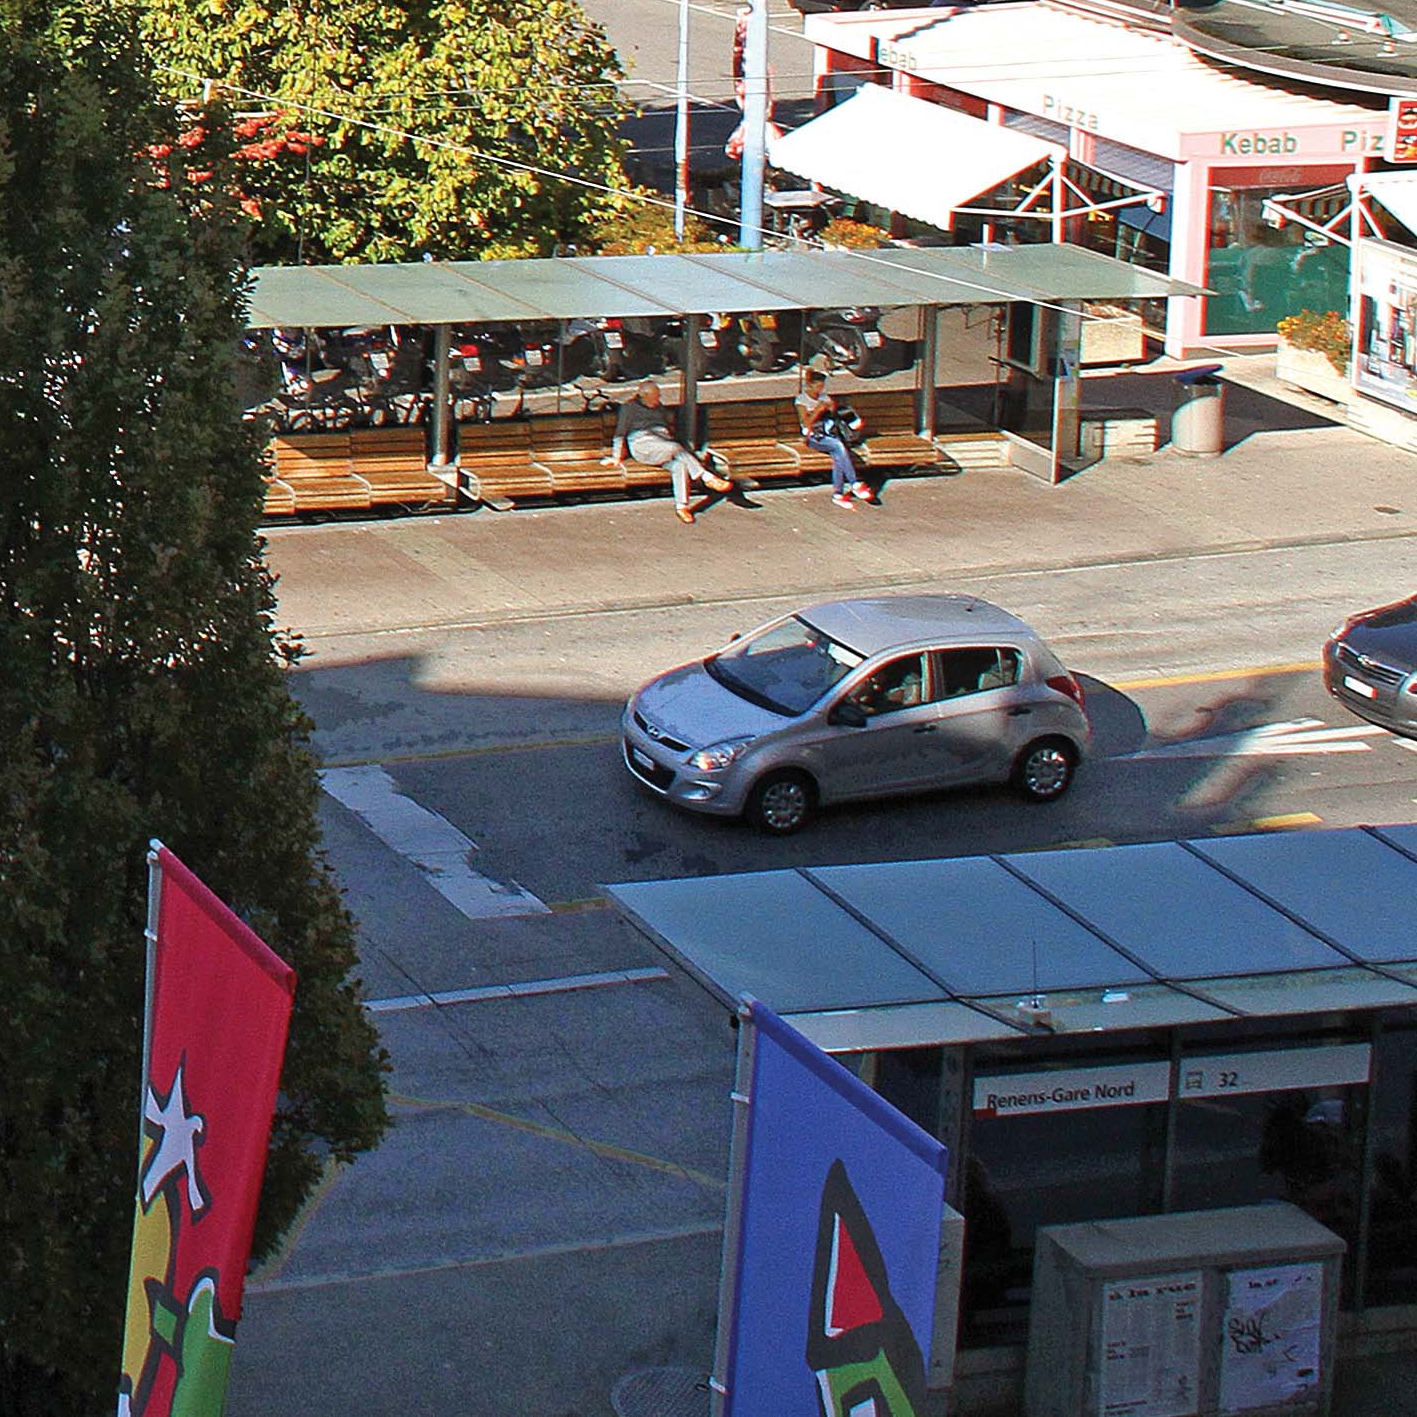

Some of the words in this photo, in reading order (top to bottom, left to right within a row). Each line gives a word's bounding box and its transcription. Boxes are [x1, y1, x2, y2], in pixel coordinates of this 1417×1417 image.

[1042, 93, 1099, 129] Pizza
[1220, 132, 1298, 155] Kebab
[987, 1087, 1090, 1110] Renens-Gare
[1094, 1081, 1135, 1099] Nord
[1218, 1072, 1239, 1087] 32
